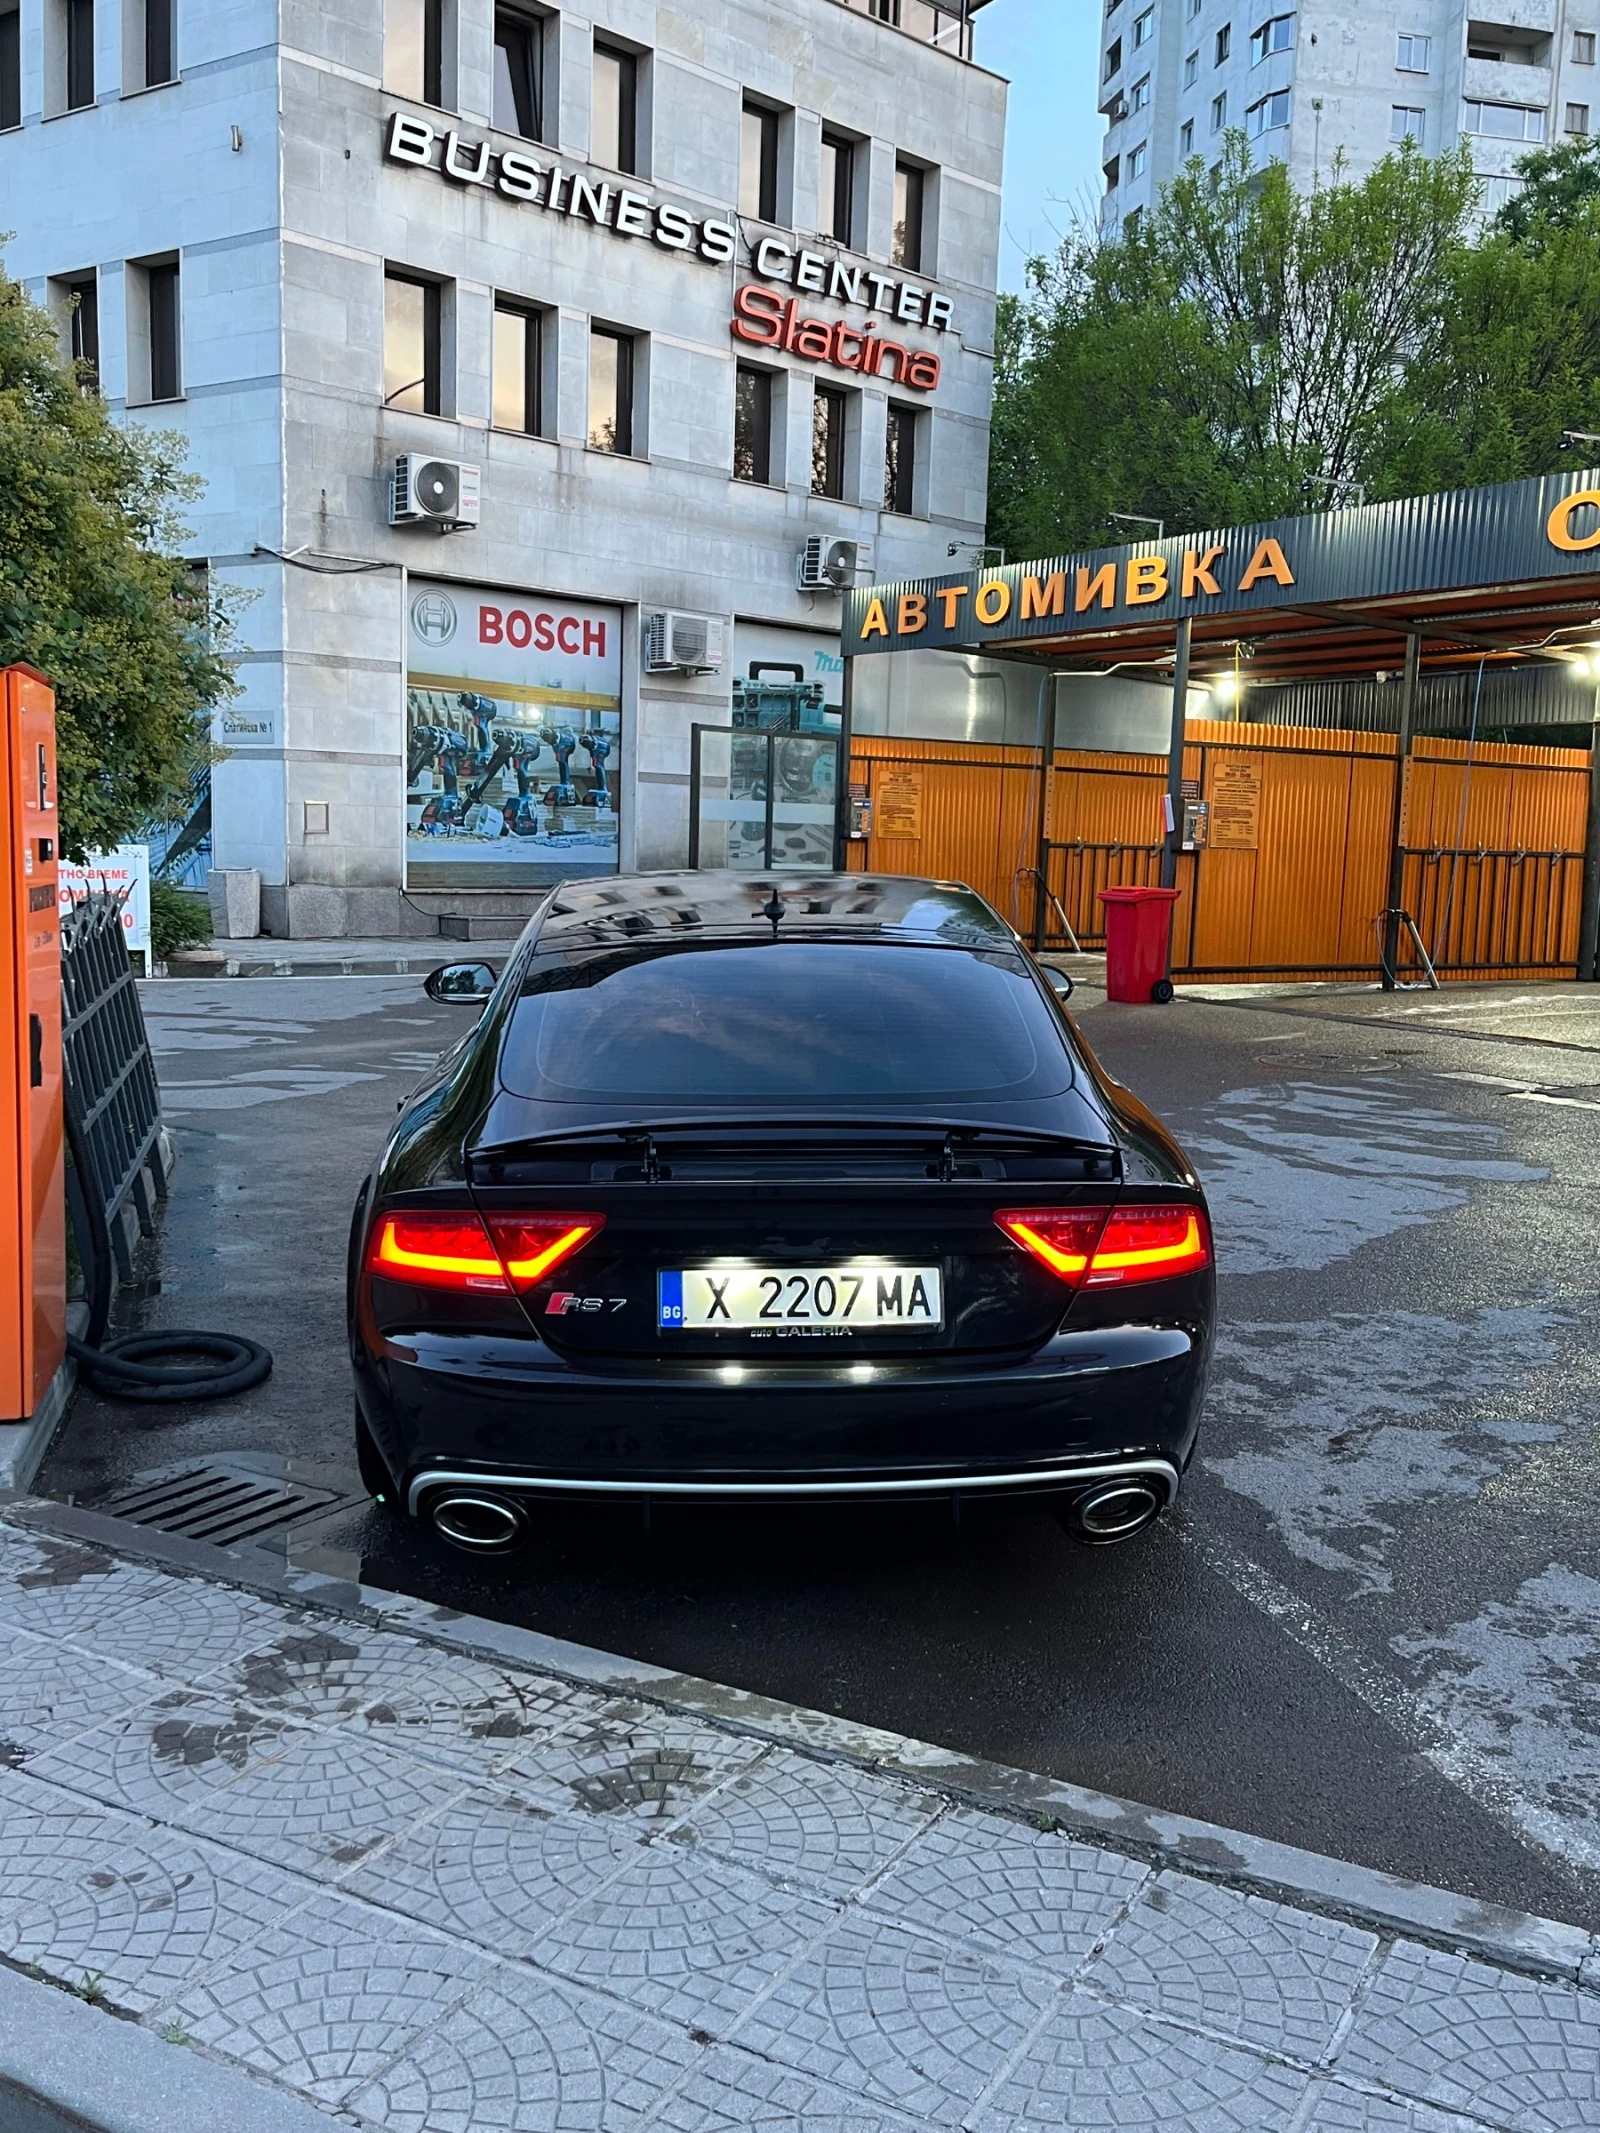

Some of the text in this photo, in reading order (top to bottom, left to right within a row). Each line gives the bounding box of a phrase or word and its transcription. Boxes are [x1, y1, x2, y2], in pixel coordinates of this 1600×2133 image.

[385, 110, 955, 332] BUSINESS CENTER
[731, 284, 942, 391] Slatina
[860, 538, 1296, 640] АВТОМИВКА
[479, 605, 606, 658] BOSCH
[58, 869, 129, 880] ТНО ВРЕМЕ
[662, 1306, 681, 1319] BG
[759, 1275, 864, 1318] 2207
[876, 1274, 932, 1317] MA
[750, 1326, 853, 1338] auto GALERIA
